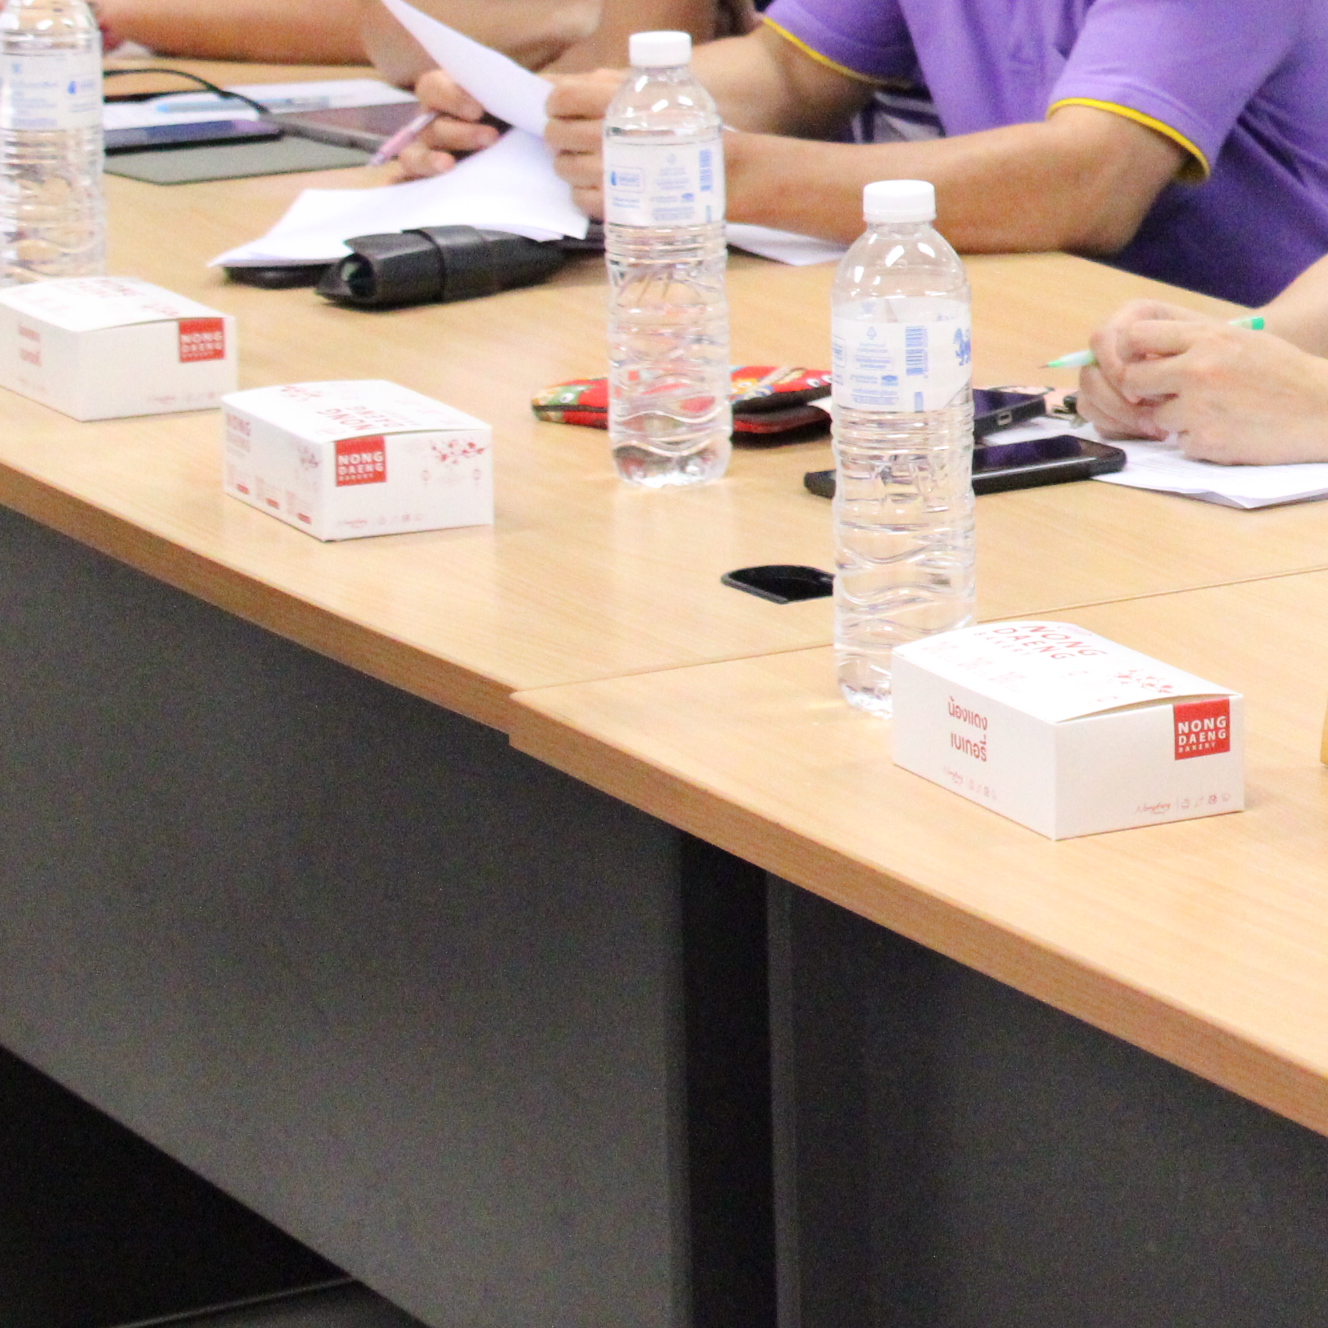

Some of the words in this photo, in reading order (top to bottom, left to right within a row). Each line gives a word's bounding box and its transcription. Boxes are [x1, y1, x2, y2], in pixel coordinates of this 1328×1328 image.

[338, 451, 385, 466] NONG
[339, 462, 385, 476] DAENG
[992, 627, 1076, 660] DAENG
[1020, 625, 1109, 656] NONG
[948, 695, 988, 731] น้องแดง
[1178, 715, 1227, 734] NONG
[950, 732, 988, 763] เบเกอรี่
[1178, 729, 1227, 746] DAENG
